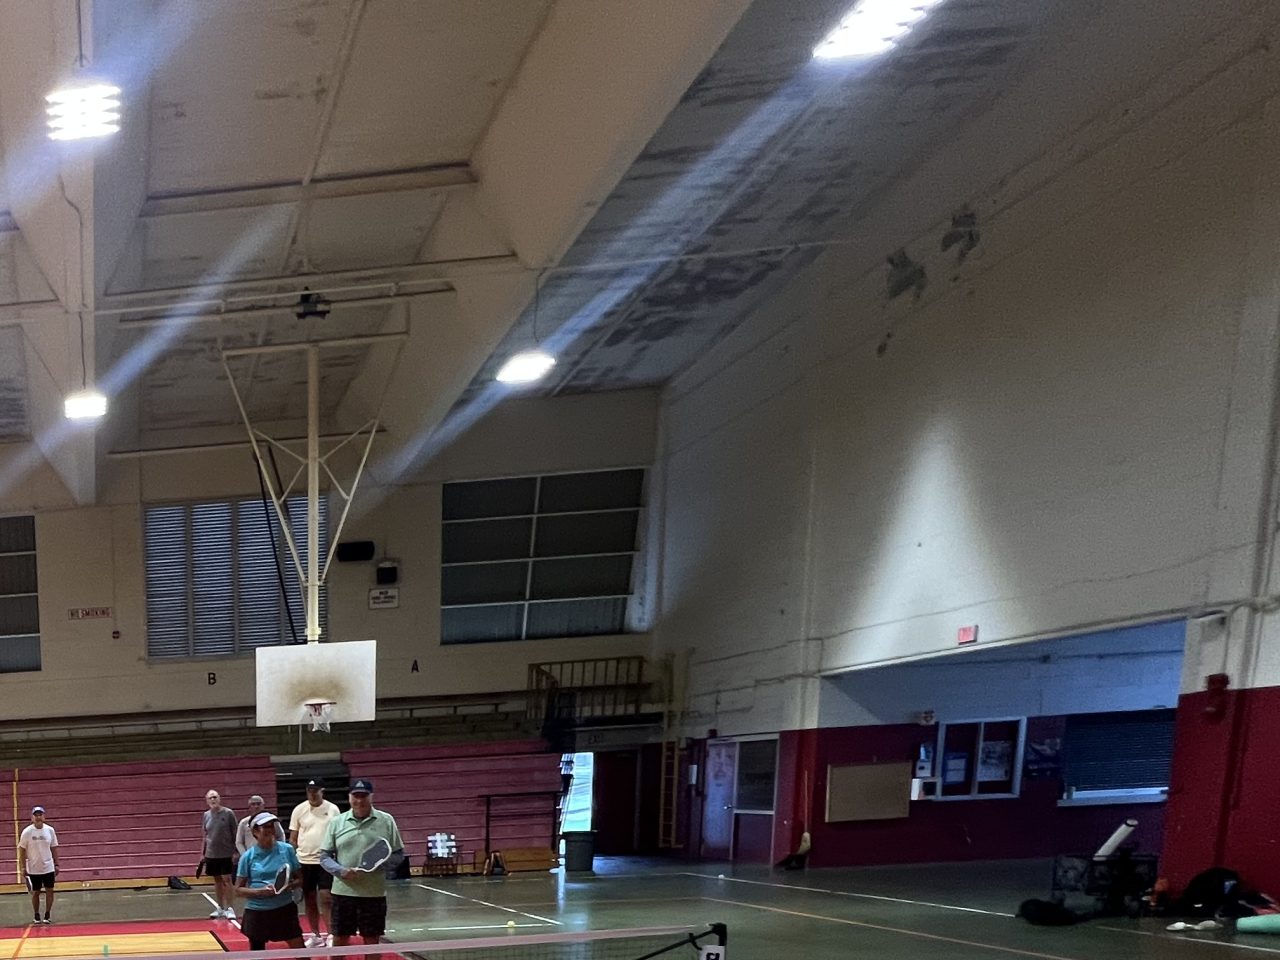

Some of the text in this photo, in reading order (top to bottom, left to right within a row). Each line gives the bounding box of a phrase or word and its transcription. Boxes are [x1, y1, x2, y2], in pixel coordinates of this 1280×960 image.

[81, 606, 111, 617] SMOKING
[411, 659, 420, 674] A
[207, 672, 217, 685] B
